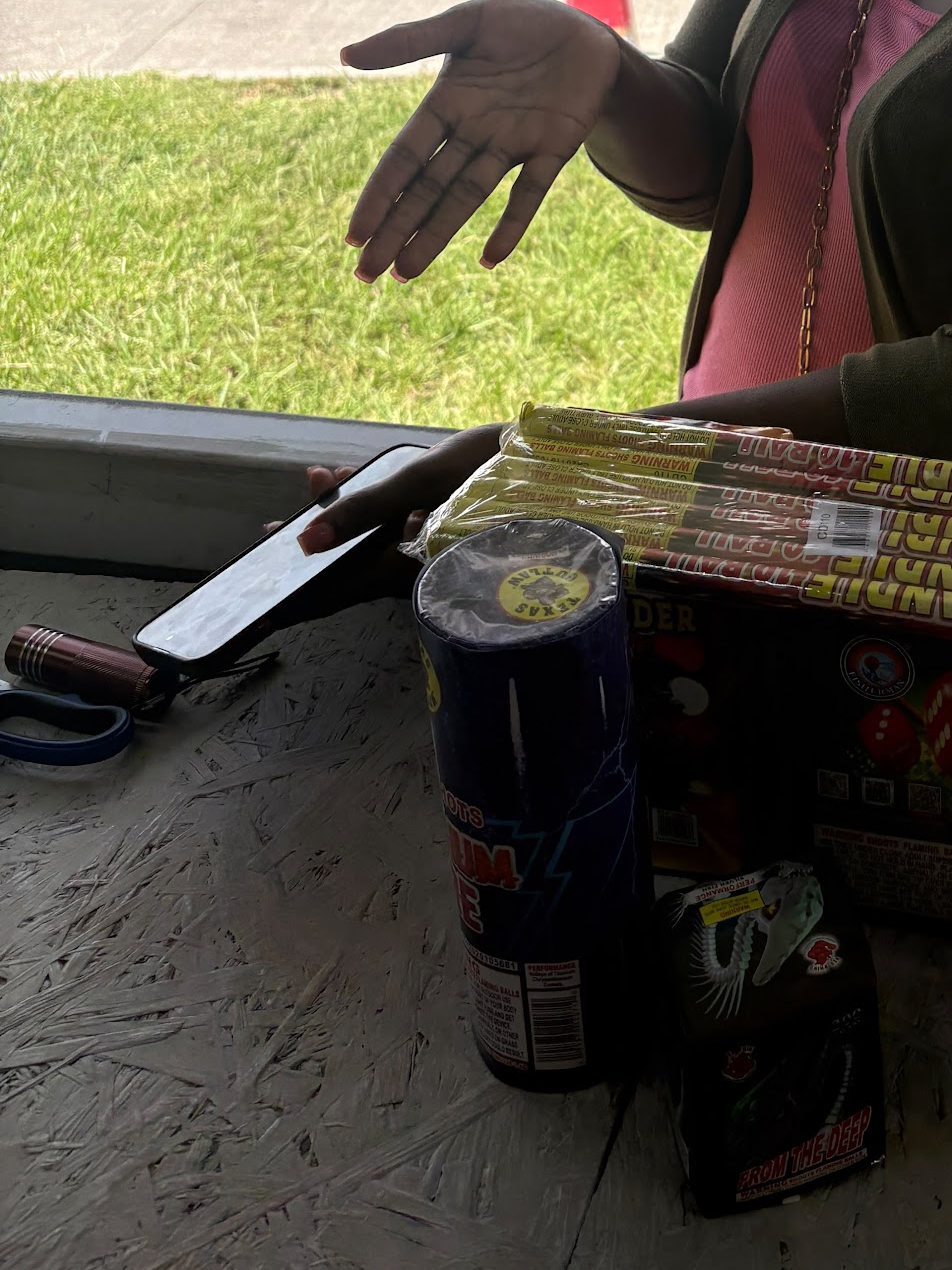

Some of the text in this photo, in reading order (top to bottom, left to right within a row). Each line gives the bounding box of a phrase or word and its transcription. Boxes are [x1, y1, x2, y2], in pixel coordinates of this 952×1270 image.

[547, 425, 572, 437] BAS
[530, 442, 556, 452] BALLS
[557, 445, 594, 457] FLAMING
[630, 454, 690, 472] WARNING
[553, 472, 590, 484] FLAMING
[640, 486, 689, 503] WARNIN
[624, 533, 661, 549] WARN
[507, 567, 579, 588] OUTLAW
[515, 597, 581, 617] TEXAS
[903, 841, 939, 855] FLAMING
[694, 878, 755, 902] PERFORMANCE
[719, 904, 751, 919] WARNING
[527, 962, 576, 972] PERFORMANCE
[737, 1104, 874, 1190] FROM THE DEEP
